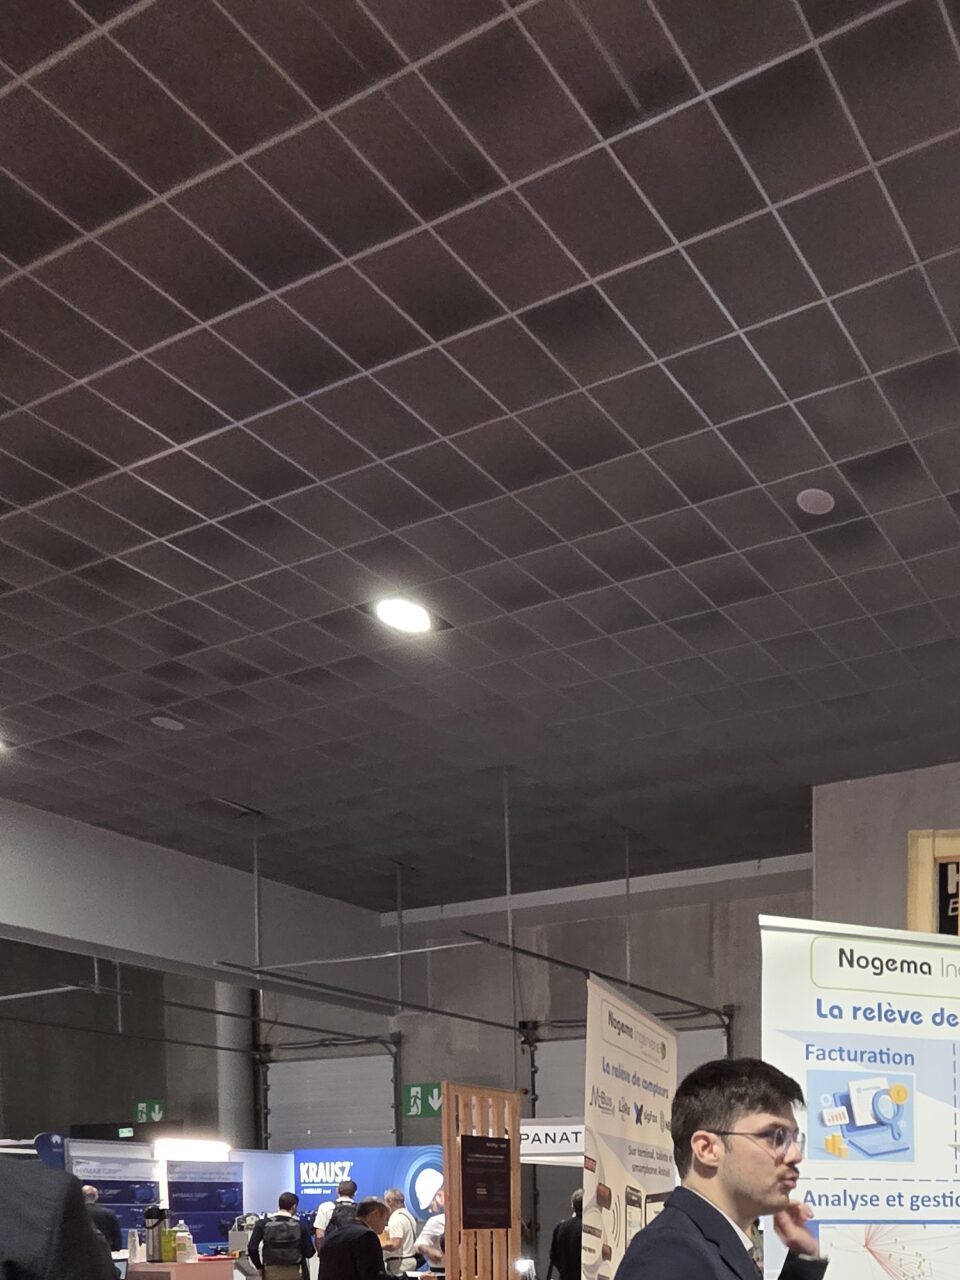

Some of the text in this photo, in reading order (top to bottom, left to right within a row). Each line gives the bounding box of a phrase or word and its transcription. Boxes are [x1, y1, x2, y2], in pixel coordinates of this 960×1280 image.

[838, 948, 932, 976] Nogema
[816, 999, 843, 1019] La
[852, 1003, 923, 1025] relève
[931, 1007, 959, 1027] de
[804, 1043, 915, 1067] Facturation
[520, 1132, 582, 1144] PANAT
[300, 1160, 352, 1183] KRAUSZ
[804, 1189, 880, 1210] Analyse
[885, 1192, 904, 1207] et
